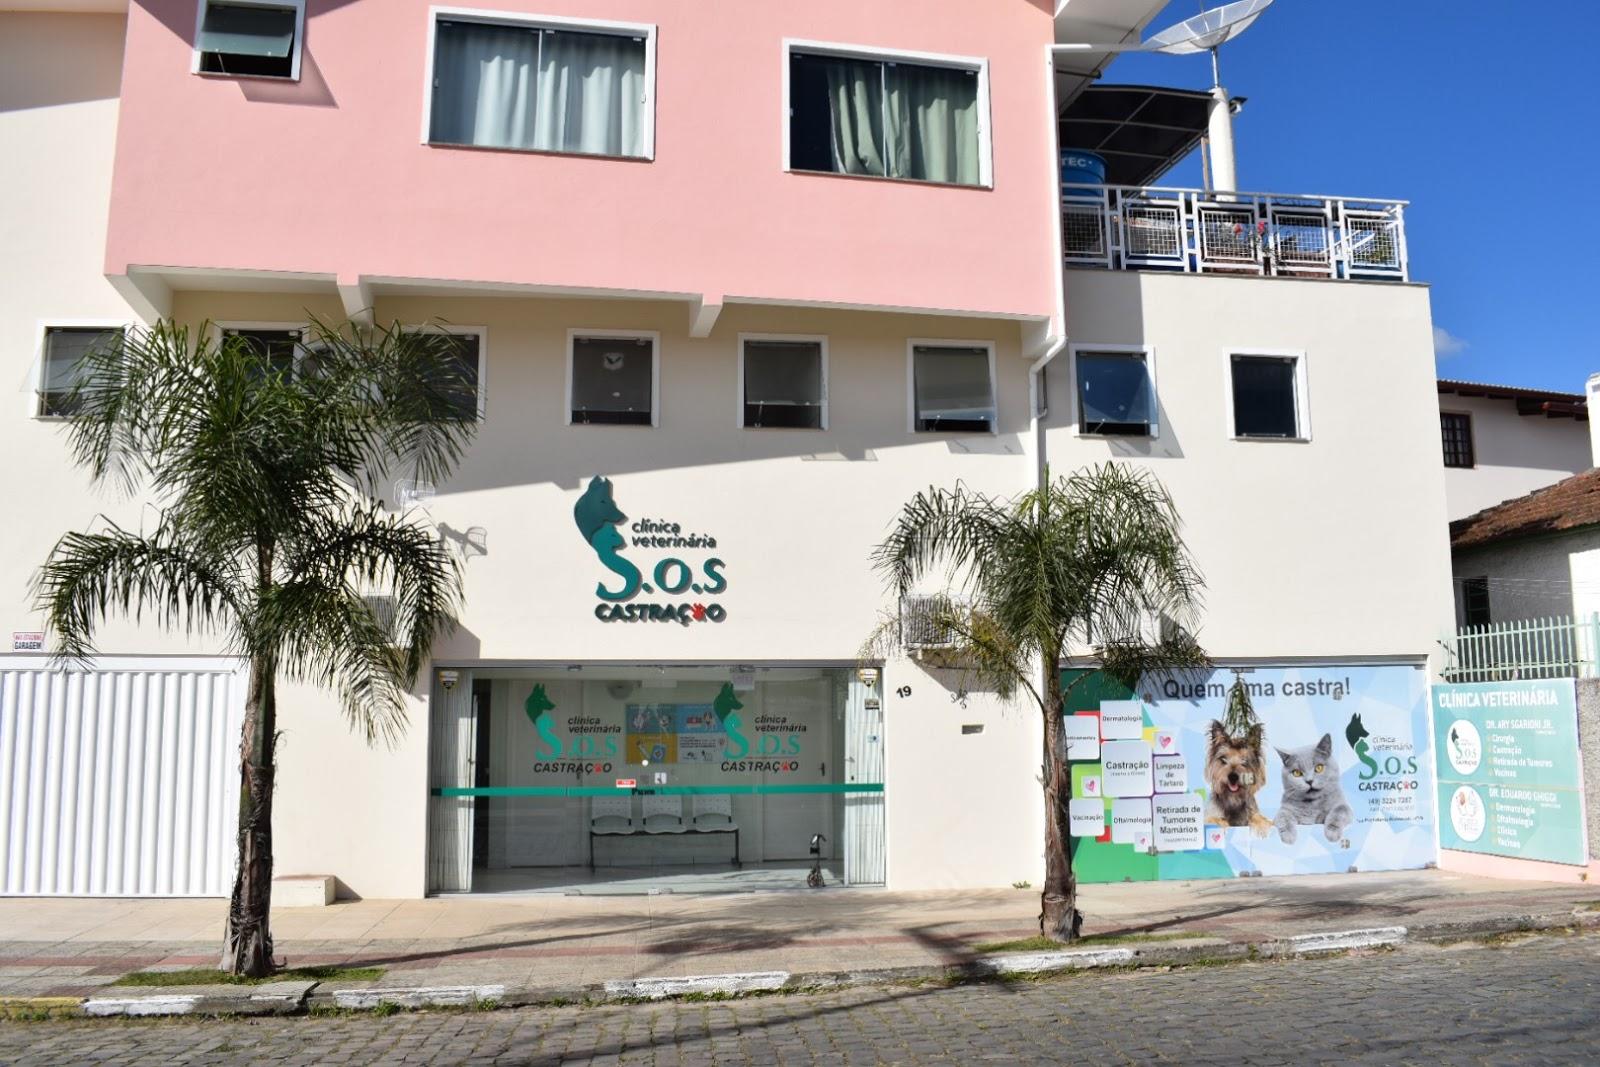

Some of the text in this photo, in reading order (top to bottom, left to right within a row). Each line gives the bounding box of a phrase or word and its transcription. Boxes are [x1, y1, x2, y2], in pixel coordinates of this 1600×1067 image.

[631, 518, 681, 534] clínica
[632, 533, 717, 548] veterinária
[595, 528, 727, 602] S.O.S
[594, 603, 727, 627] CASTRAÇO
[896, 685, 912, 698] 19
[1164, 680, 1225, 699] Quem
[1282, 677, 1350, 697] castra!
[1439, 686, 1558, 708] CLÍNICA VETERINÁRIA
[568, 716, 600, 725] clínica
[754, 715, 787, 724] clínica
[1102, 715, 1143, 724] Dermatologia
[755, 724, 807, 733] veterinária
[1105, 761, 1149, 771] Castração
[1359, 742, 1418, 780] S.O.S
[533, 762, 613, 776] CASTRAÇO
[720, 761, 799, 774] CASTRAÇO
[1156, 762, 1185, 772] Limpeza
[1359, 781, 1418, 792] CASTRAÇO
[1156, 804, 1201, 815] Retirada de
[1113, 816, 1152, 825] Oftalmologia
[1162, 815, 1196, 825] Tumores
[1160, 825, 1198, 835] Mamários
